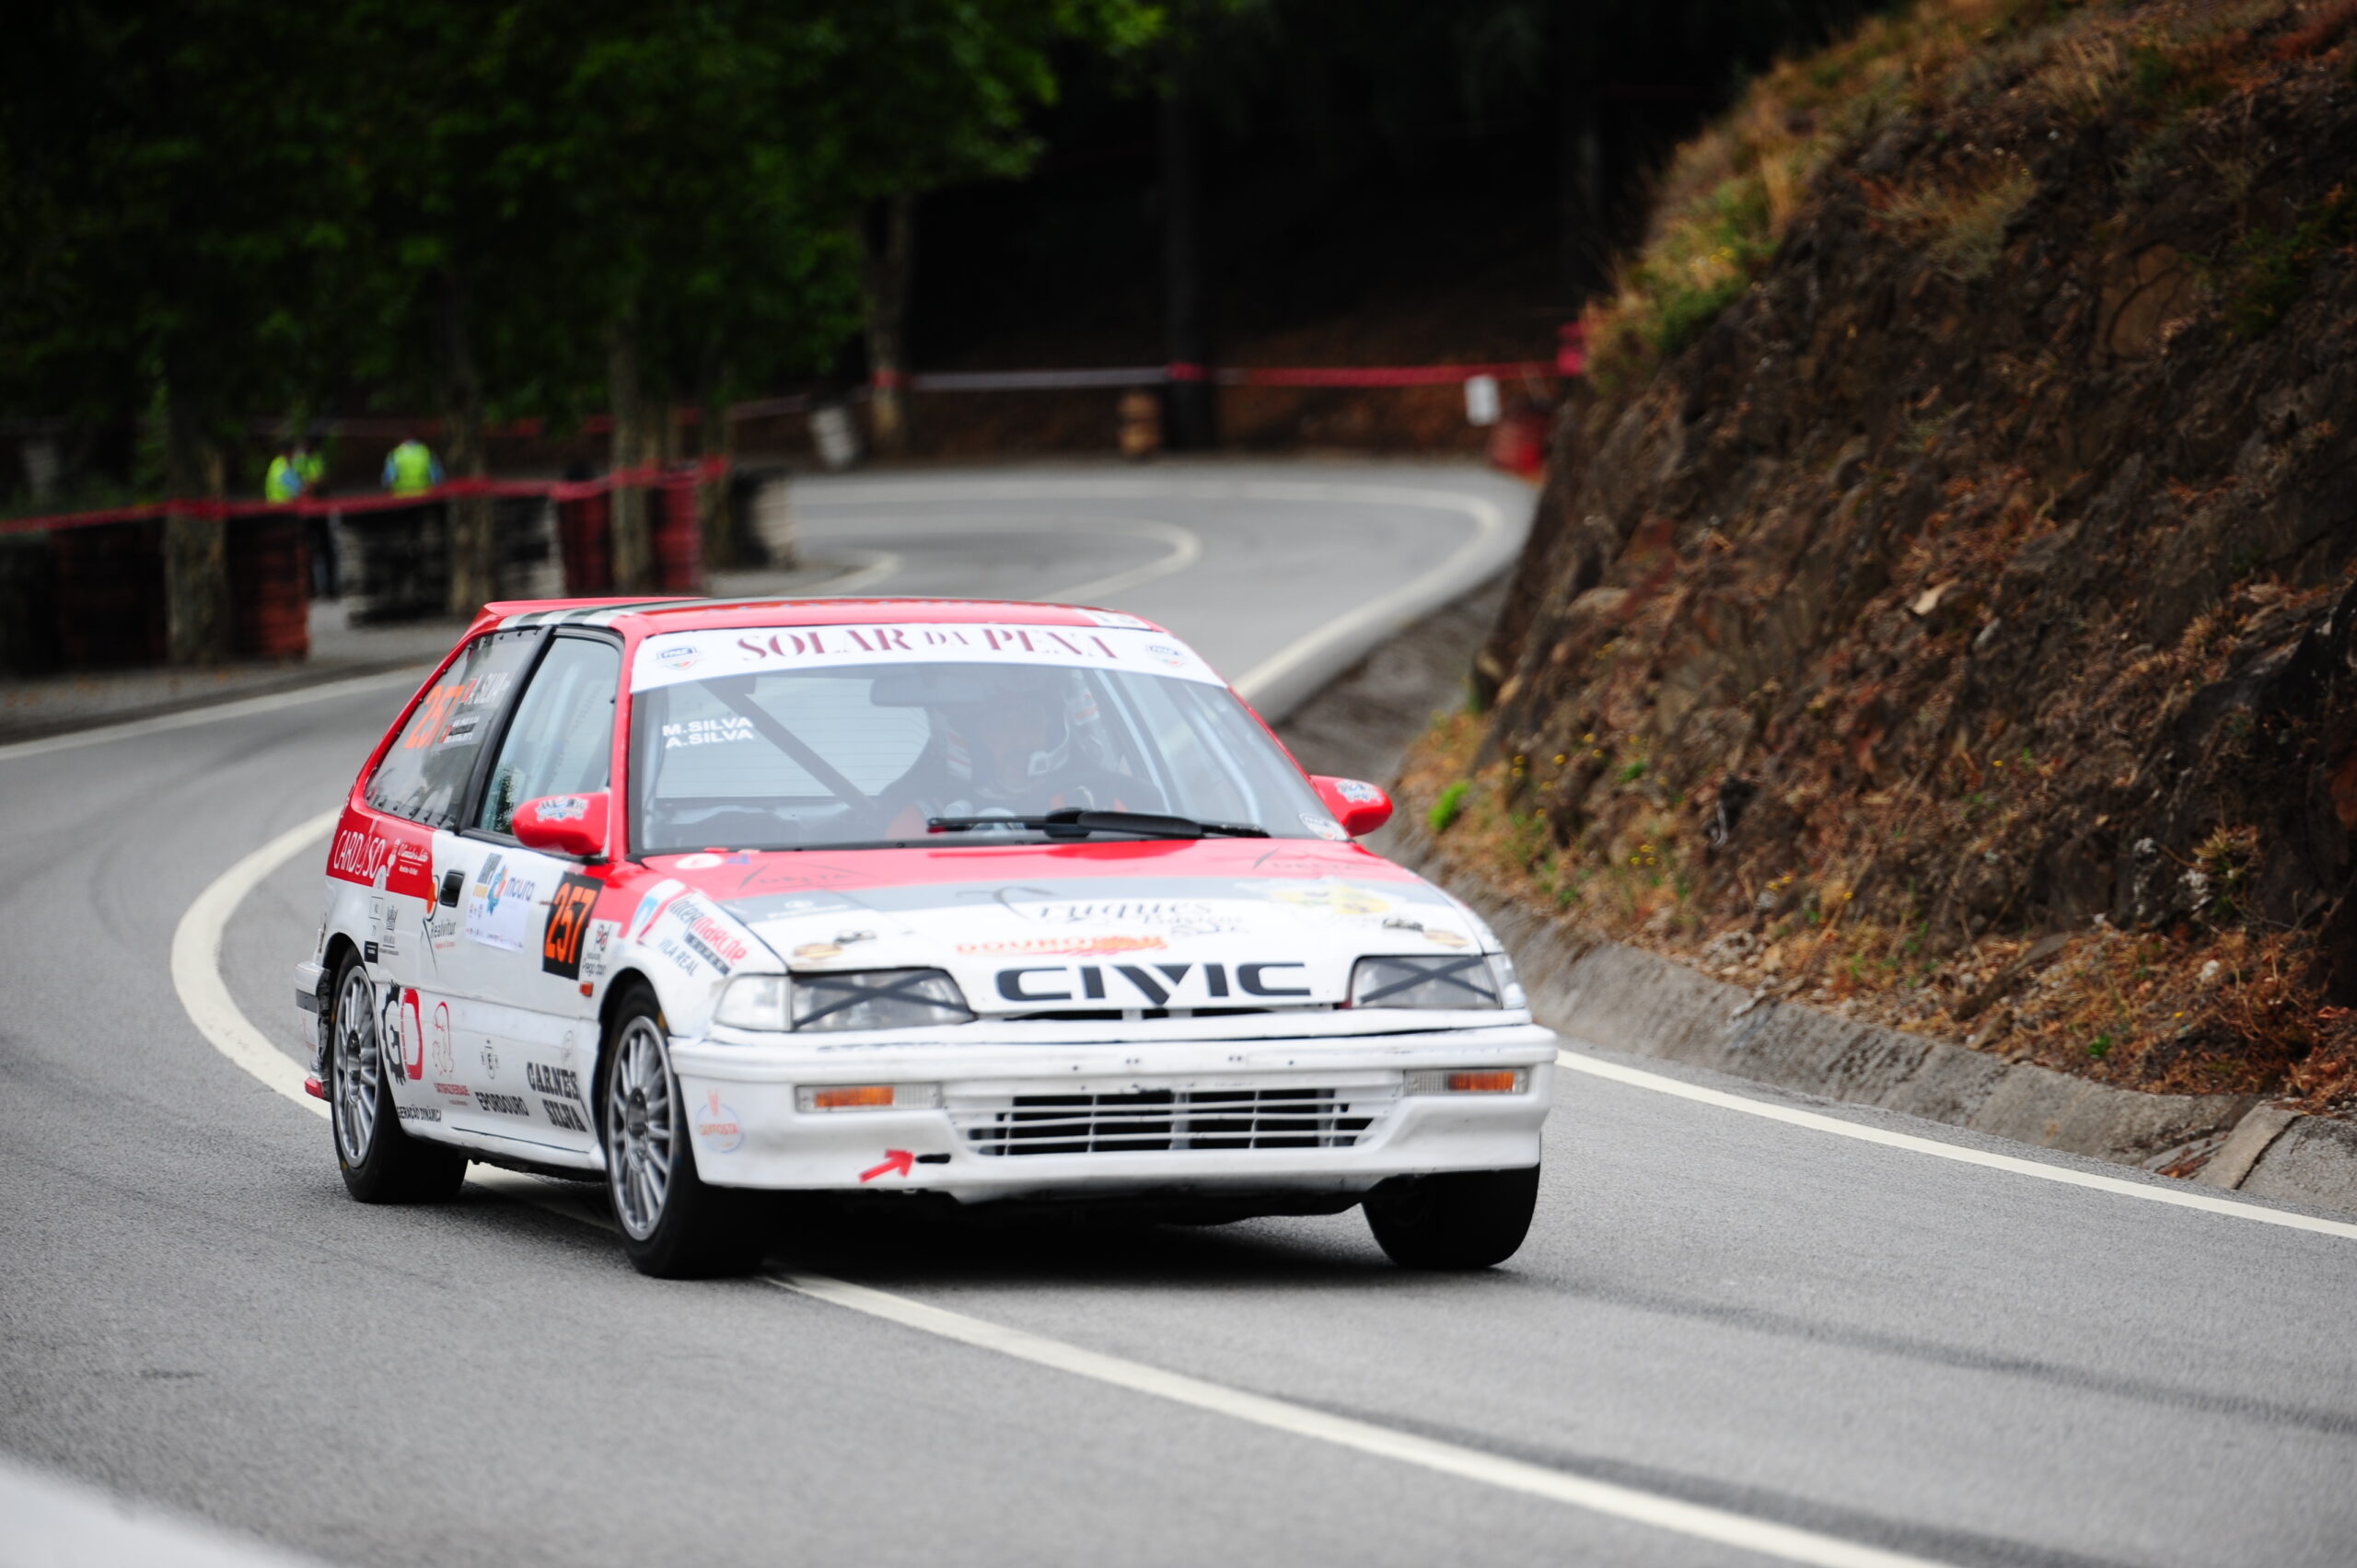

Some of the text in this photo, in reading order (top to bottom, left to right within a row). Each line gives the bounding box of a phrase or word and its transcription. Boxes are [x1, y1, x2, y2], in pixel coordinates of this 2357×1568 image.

[737, 628, 1120, 662] SOLAR DA PENA
[662, 716, 754, 737] M.SILVA
[665, 728, 755, 749] A.SILVA
[544, 881, 598, 964] 257
[994, 961, 1312, 1006] CIVIC
[527, 1061, 580, 1101] CARNES
[541, 1098, 588, 1133] SILVA
